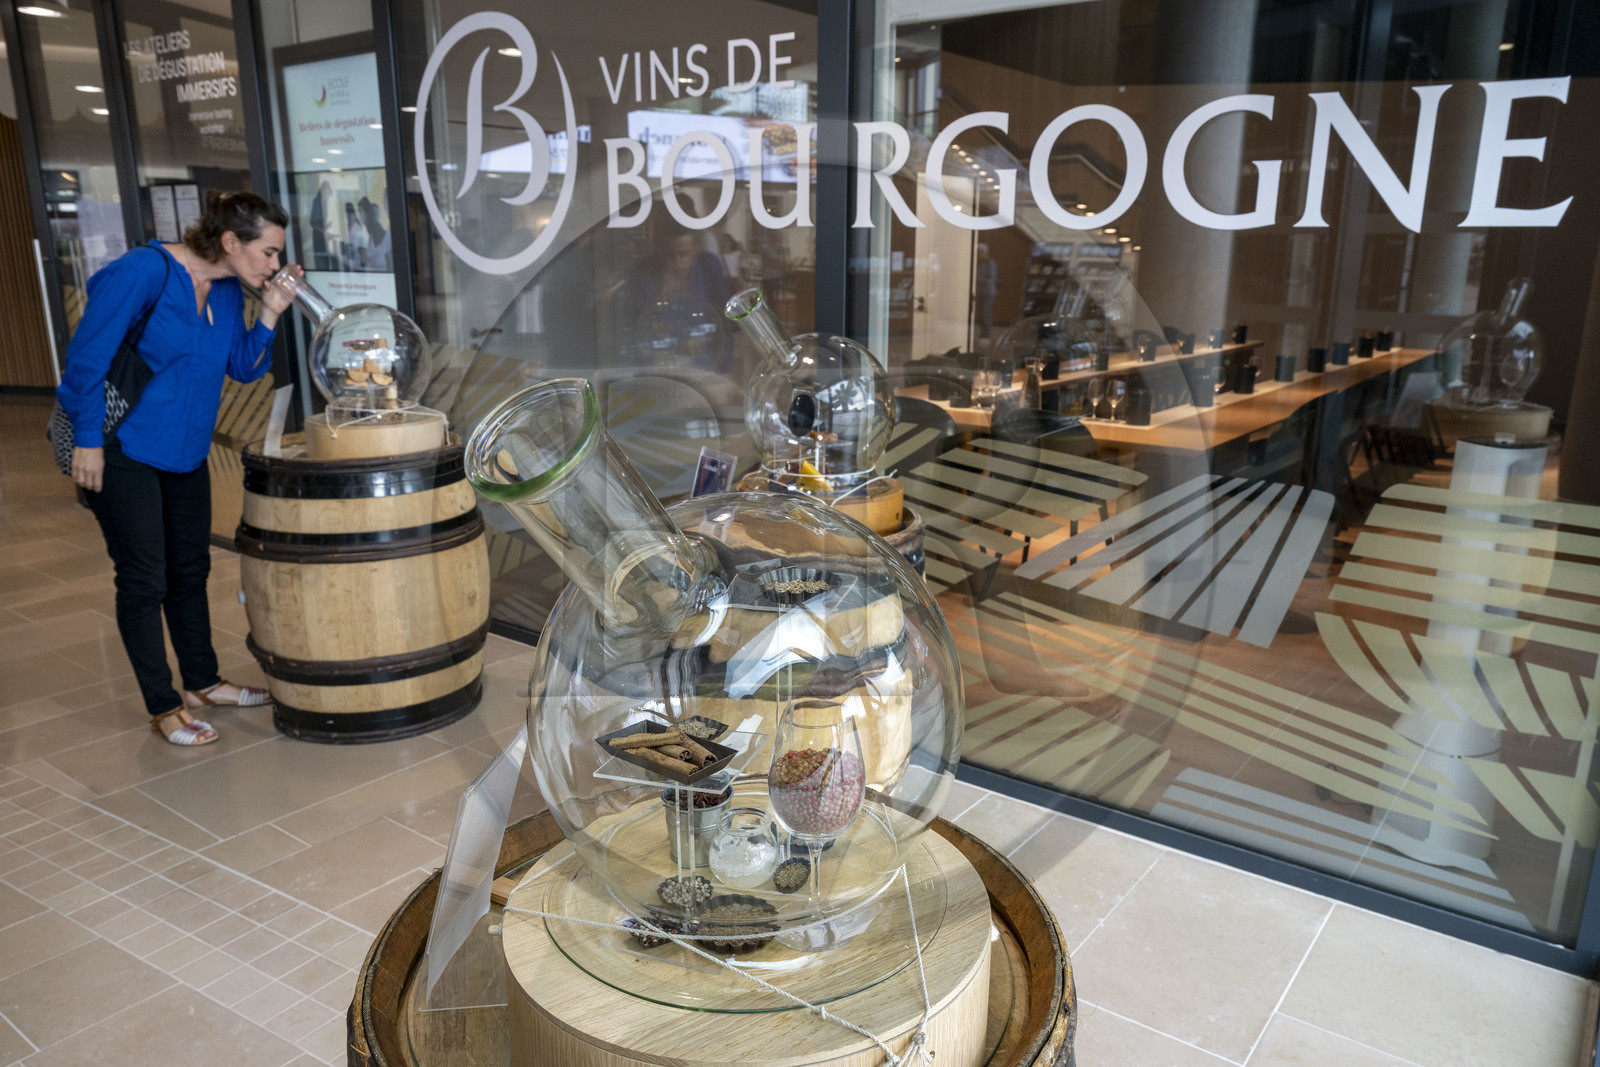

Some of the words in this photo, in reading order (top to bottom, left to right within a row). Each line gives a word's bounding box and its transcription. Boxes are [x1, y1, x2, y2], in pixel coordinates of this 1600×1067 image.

[143, 29, 191, 55] ATELIERS
[152, 51, 225, 80] DÉGUSTATION
[598, 43, 710, 105] VINS
[727, 31, 796, 94] DE
[176, 76, 237, 103] IMMERSIFS
[603, 75, 1574, 234] BOURGOGNE
